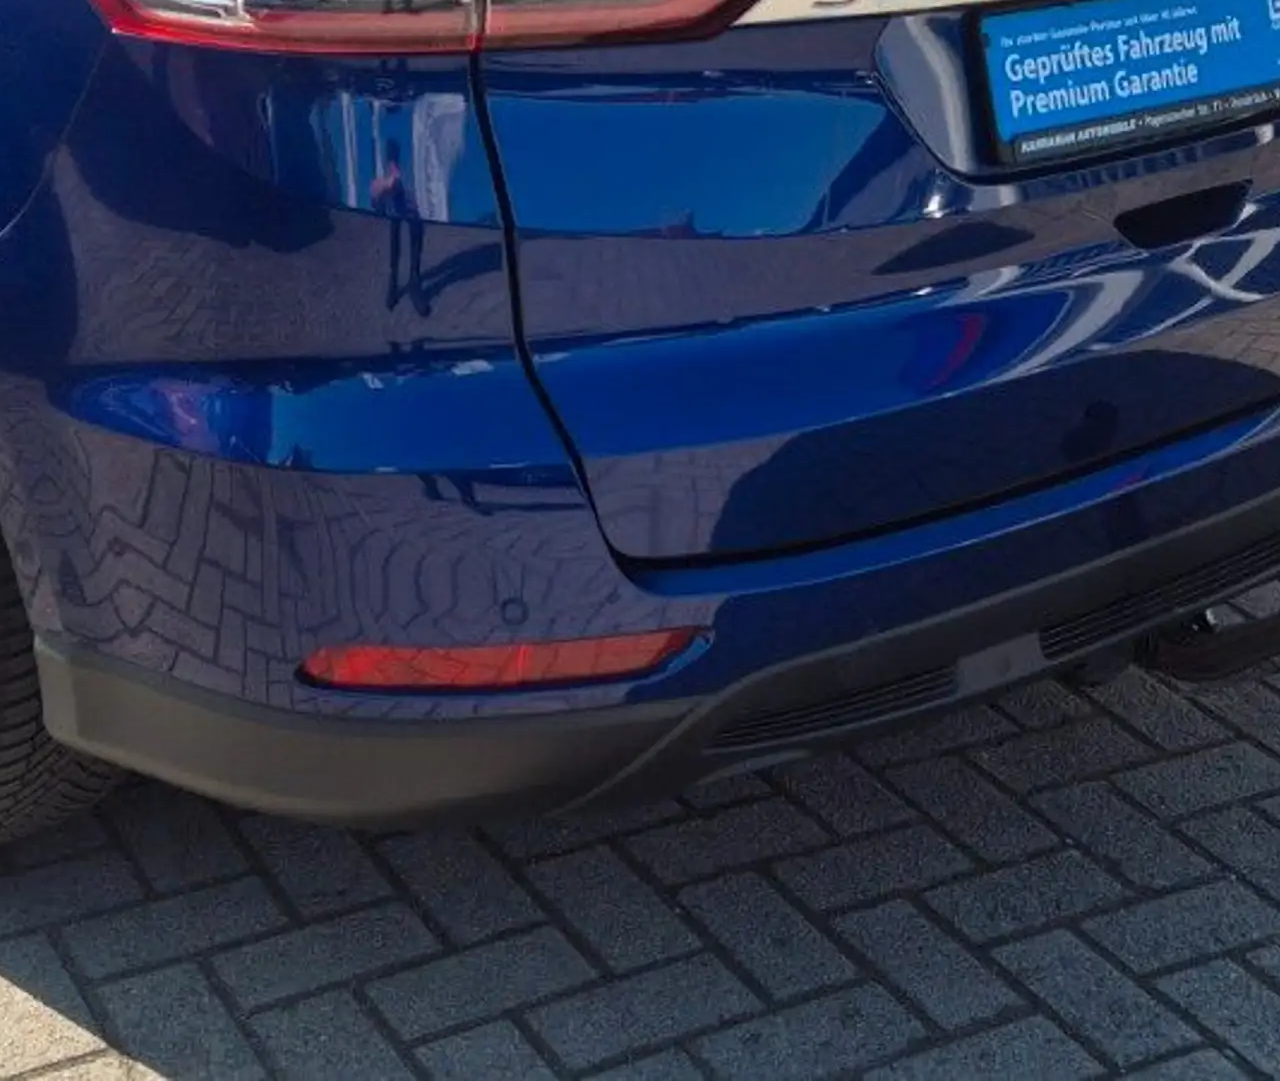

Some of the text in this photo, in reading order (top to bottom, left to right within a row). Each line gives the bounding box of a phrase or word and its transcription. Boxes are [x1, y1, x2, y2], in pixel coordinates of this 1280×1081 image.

[1004, 40, 1114, 84] Geprüftes
[1116, 26, 1209, 56] Fahrzeug
[1210, 16, 1242, 44] mit
[1009, 56, 1199, 119] Premium Garantie
